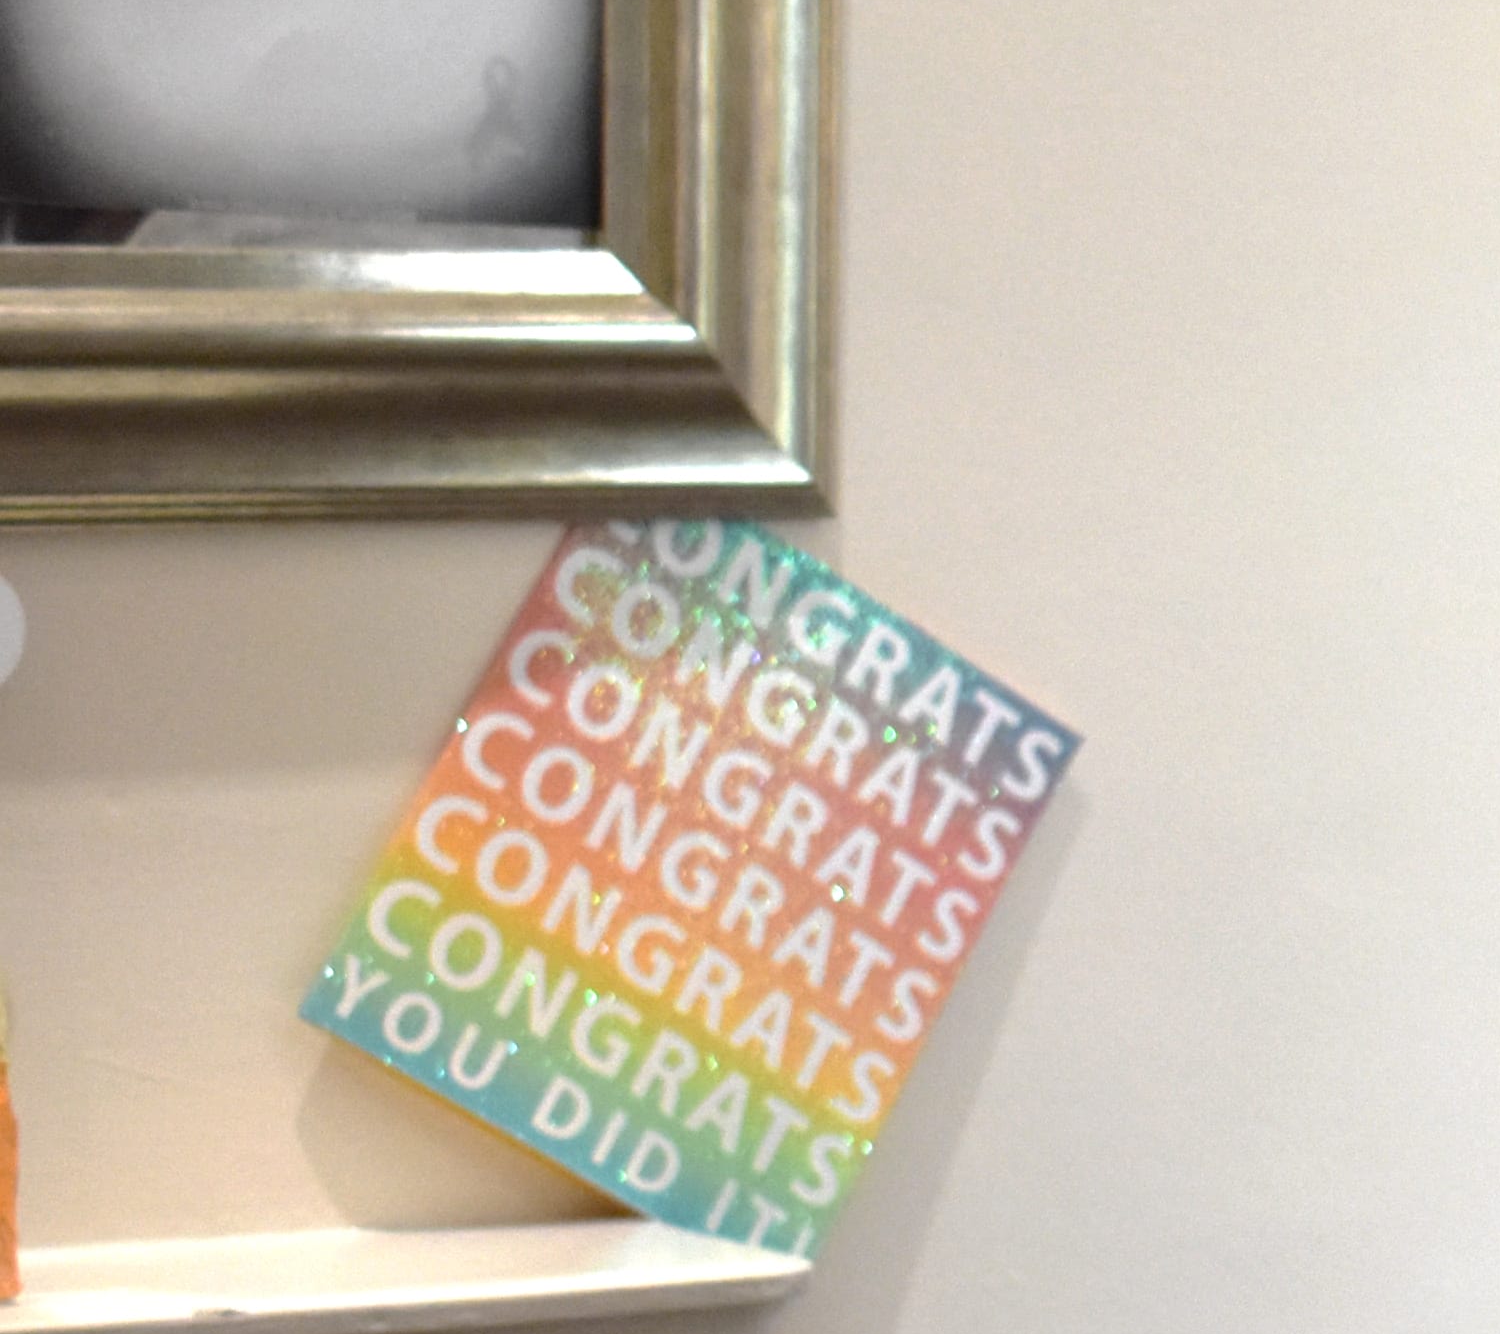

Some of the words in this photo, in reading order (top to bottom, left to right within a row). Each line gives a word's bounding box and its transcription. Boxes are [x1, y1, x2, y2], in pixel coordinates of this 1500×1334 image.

[509, 629, 979, 962] CONGRATS
[555, 547, 1022, 879] CONGRATS
[608, 519, 1062, 800] ONGRATS
[416, 795, 894, 1123] CONGRATS
[461, 711, 938, 1041] CONGRATS
[334, 954, 507, 1090] YOU
[531, 1076, 680, 1192] DID
[366, 880, 853, 1207] CONGRATS
